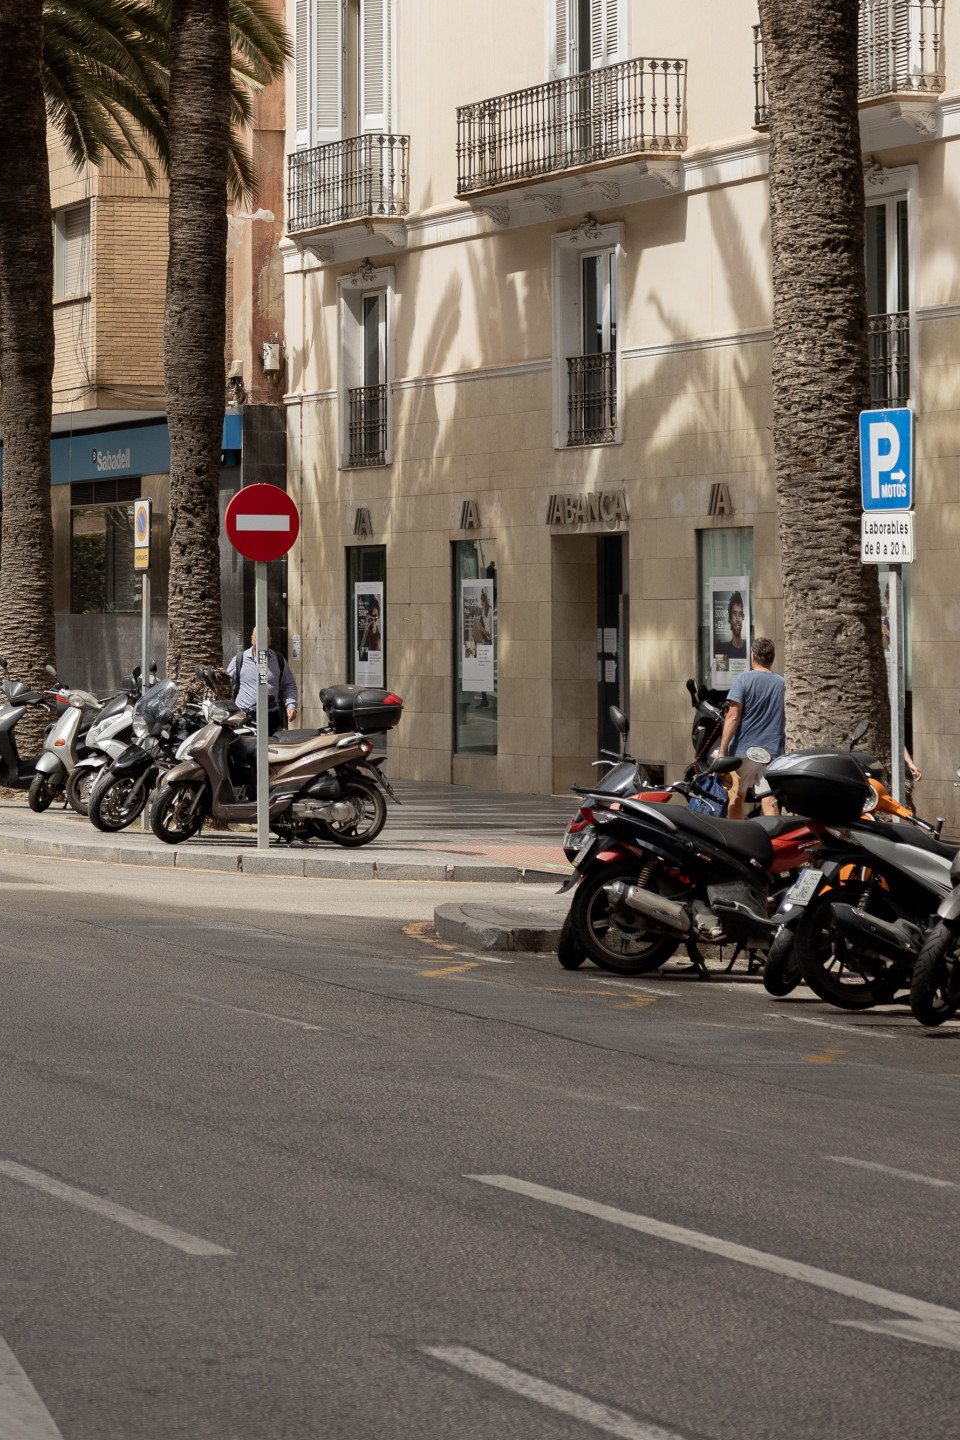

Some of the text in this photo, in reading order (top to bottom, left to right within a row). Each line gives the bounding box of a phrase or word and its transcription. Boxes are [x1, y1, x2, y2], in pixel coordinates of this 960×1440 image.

[96, 447, 131, 472] Sabadell
[869, 421, 901, 499] P
[881, 483, 907, 498] MOTOS
[546, 489, 628, 525] ABANCA
[864, 520, 909, 535] Laborables
[864, 541, 910, 556] de 8 a 20 h.
